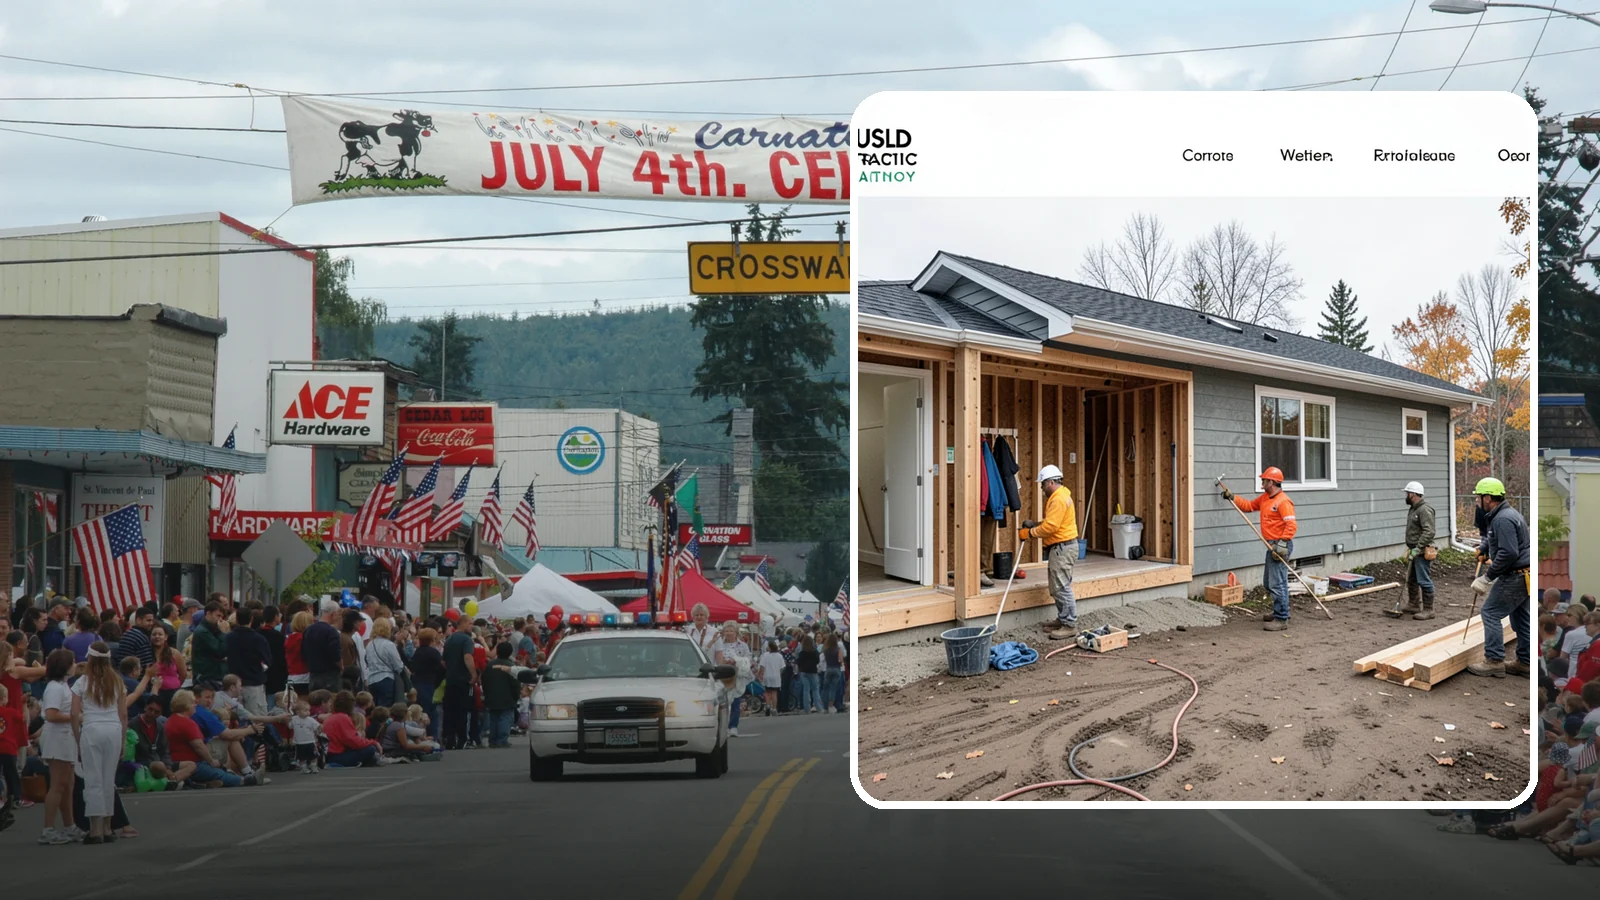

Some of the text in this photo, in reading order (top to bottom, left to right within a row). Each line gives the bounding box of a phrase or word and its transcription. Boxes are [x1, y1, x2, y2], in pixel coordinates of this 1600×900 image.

[695, 121, 850, 149] Carnat
[481, 141, 605, 193] JULY
[632, 151, 746, 197] 4th.
[697, 254, 850, 280] CROSSWA
[282, 380, 374, 420] ACE
[405, 409, 485, 422] CEDAR LOG
[283, 421, 371, 437] Hardware
[416, 428, 477, 447] Coca-Cola
[353, 467, 385, 480] Simpl
[95, 485, 124, 495] Vincent
[126, 486, 136, 495] de
[137, 486, 155, 495] Paul
[212, 516, 331, 535] HARDARE
[688, 526, 742, 535] CRNATION
[699, 535, 730, 543] GLASS
